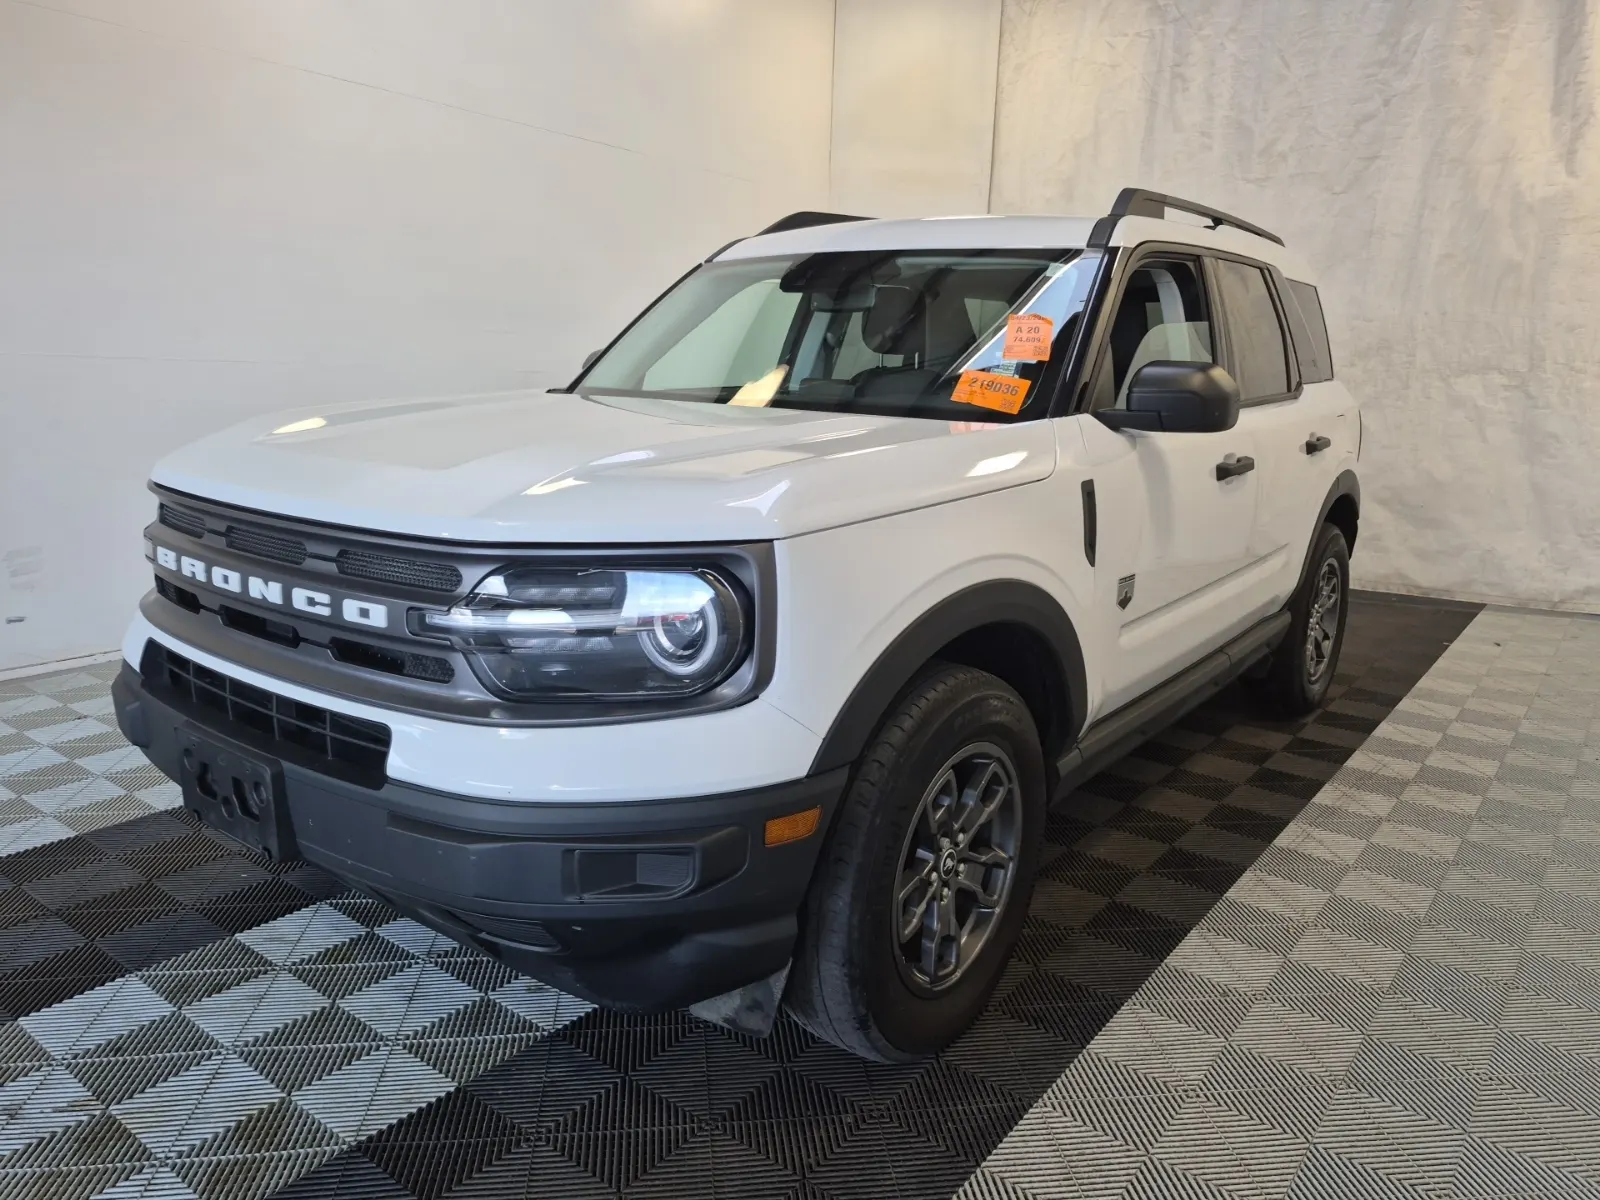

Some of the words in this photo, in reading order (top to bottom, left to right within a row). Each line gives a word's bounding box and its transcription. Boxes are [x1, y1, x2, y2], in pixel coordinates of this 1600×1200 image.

[1016, 326, 1023, 334] A
[1026, 326, 1040, 334] 20
[968, 377, 1020, 396] 219036
[157, 546, 387, 628] BRONCO
